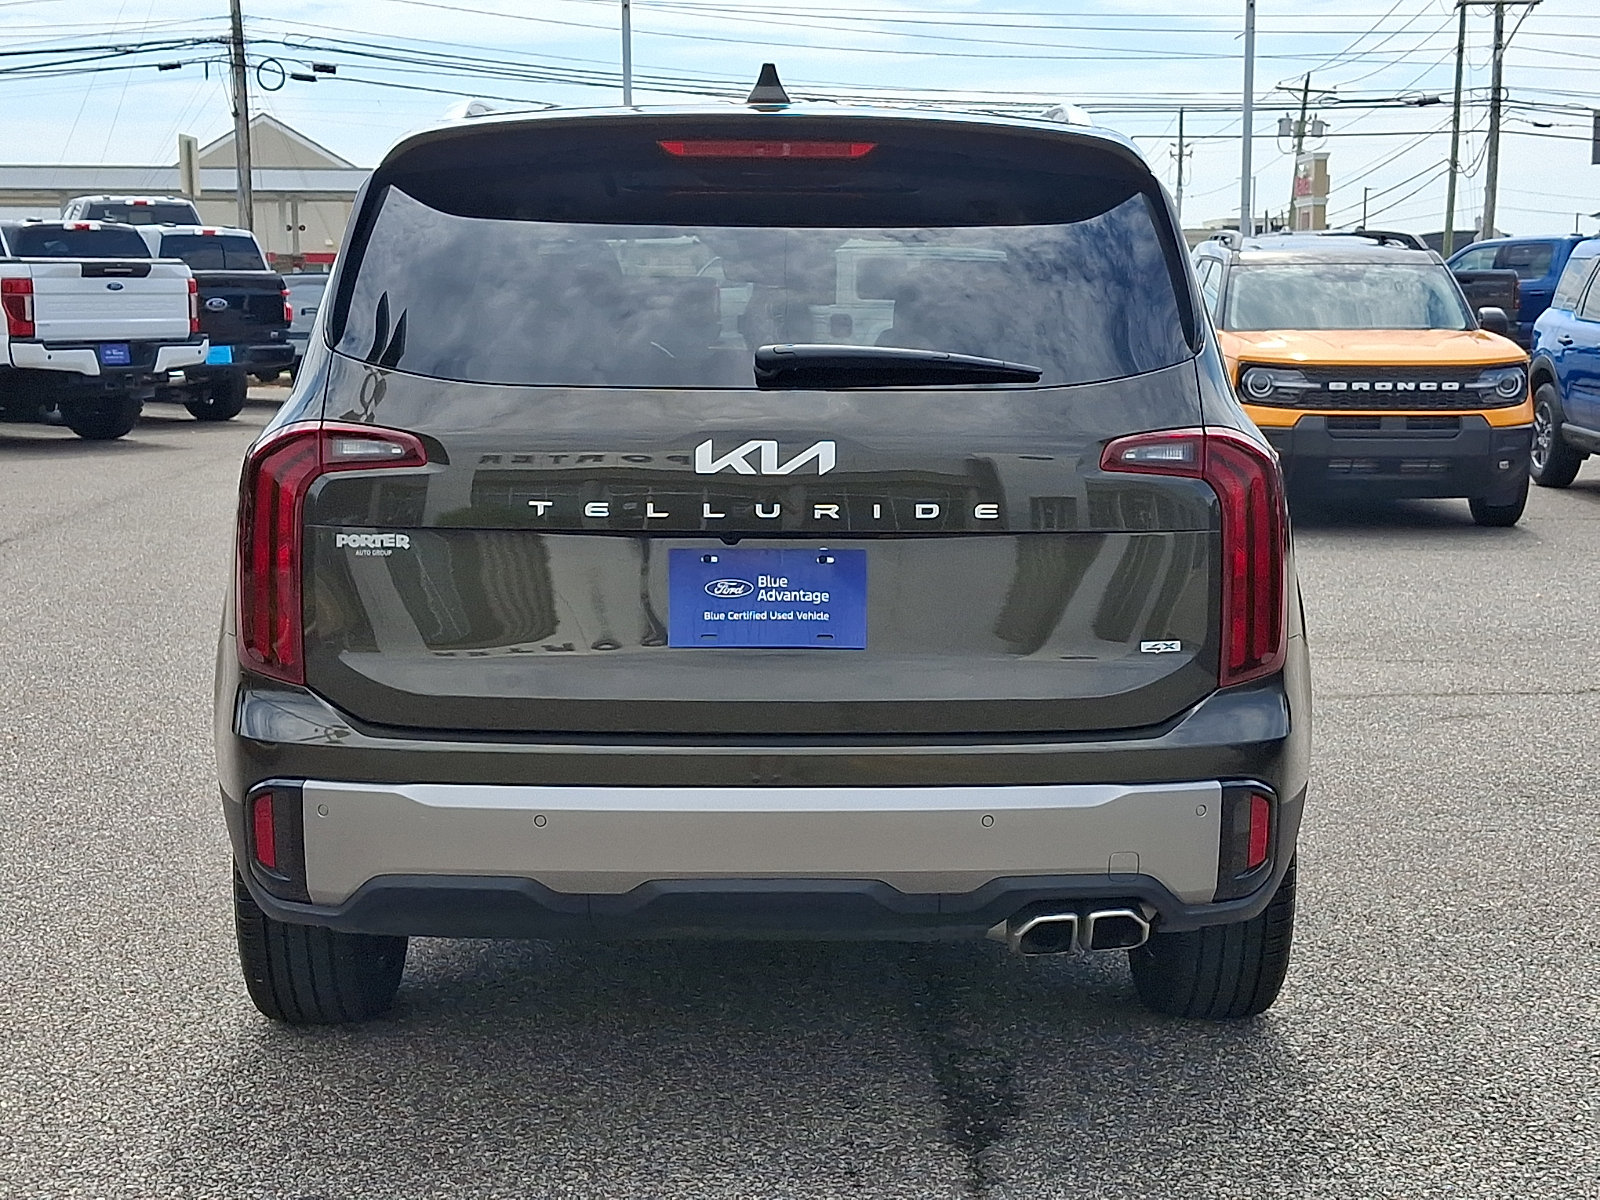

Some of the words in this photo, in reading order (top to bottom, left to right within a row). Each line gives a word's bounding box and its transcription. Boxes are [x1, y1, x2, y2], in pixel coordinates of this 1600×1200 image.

[1328, 382, 1460, 391] BRONCO
[695, 439, 836, 476] KIA
[528, 501, 999, 519] TELLURIDE
[336, 533, 410, 550] PORTER
[713, 581, 745, 595] Ford
[758, 575, 788, 588] Blue
[757, 589, 830, 604] Advantage
[704, 611, 726, 621] Blue
[727, 611, 767, 621] Certified
[769, 611, 794, 621] Used
[796, 611, 830, 621] Vehicle
